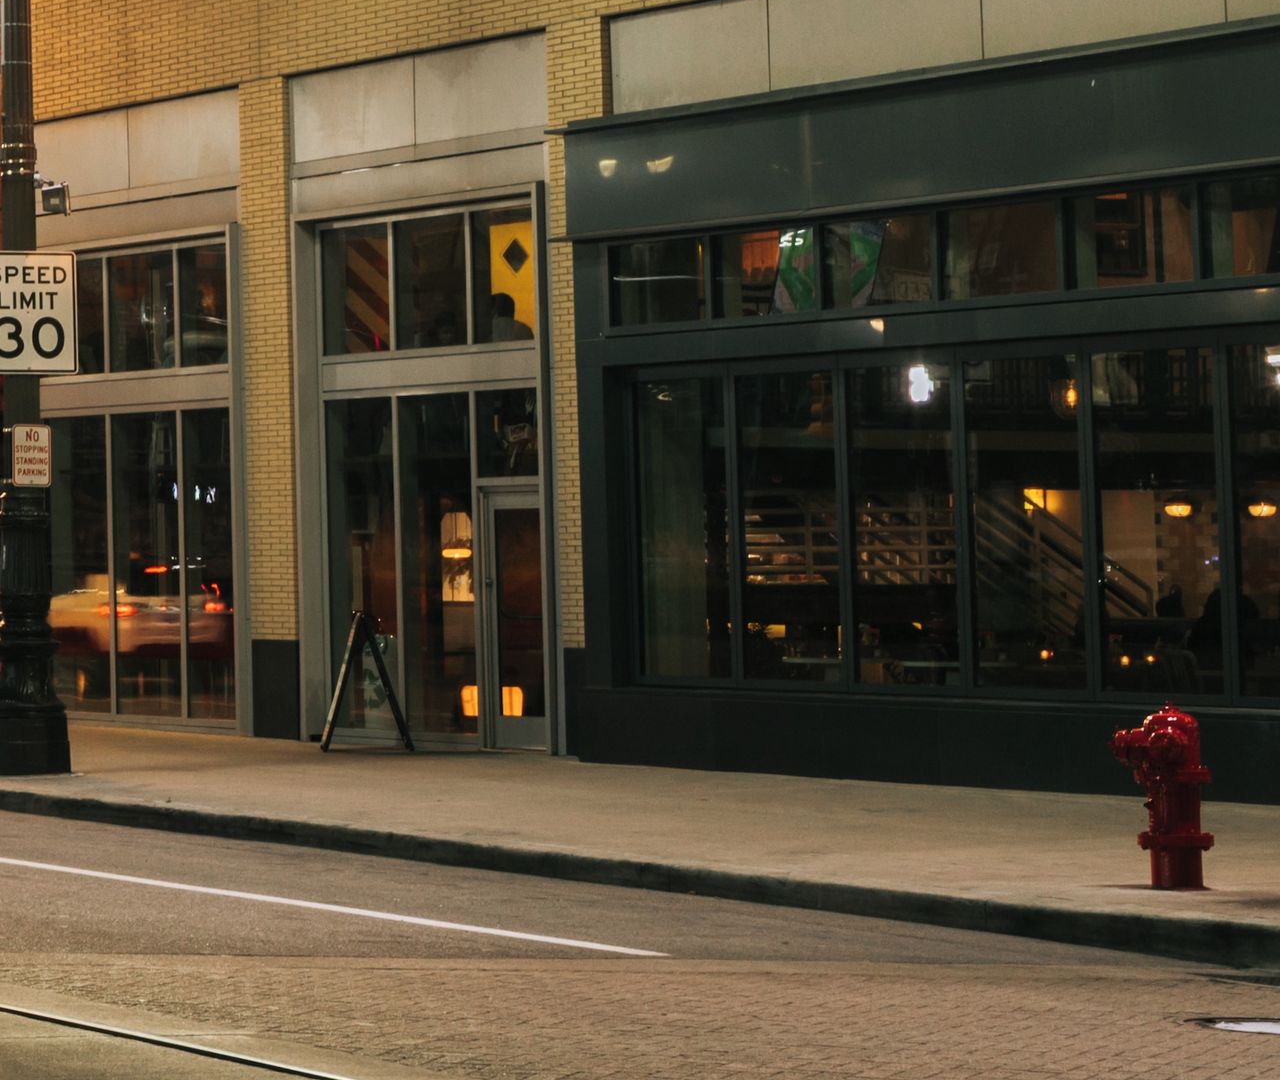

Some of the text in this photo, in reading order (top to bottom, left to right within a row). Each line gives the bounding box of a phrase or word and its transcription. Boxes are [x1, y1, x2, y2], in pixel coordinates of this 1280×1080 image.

[25, 430, 40, 442] NO
[15, 445, 48, 454] STOPPING
[15, 456, 48, 465] STANDING
[17, 468, 47, 476] PARKING
